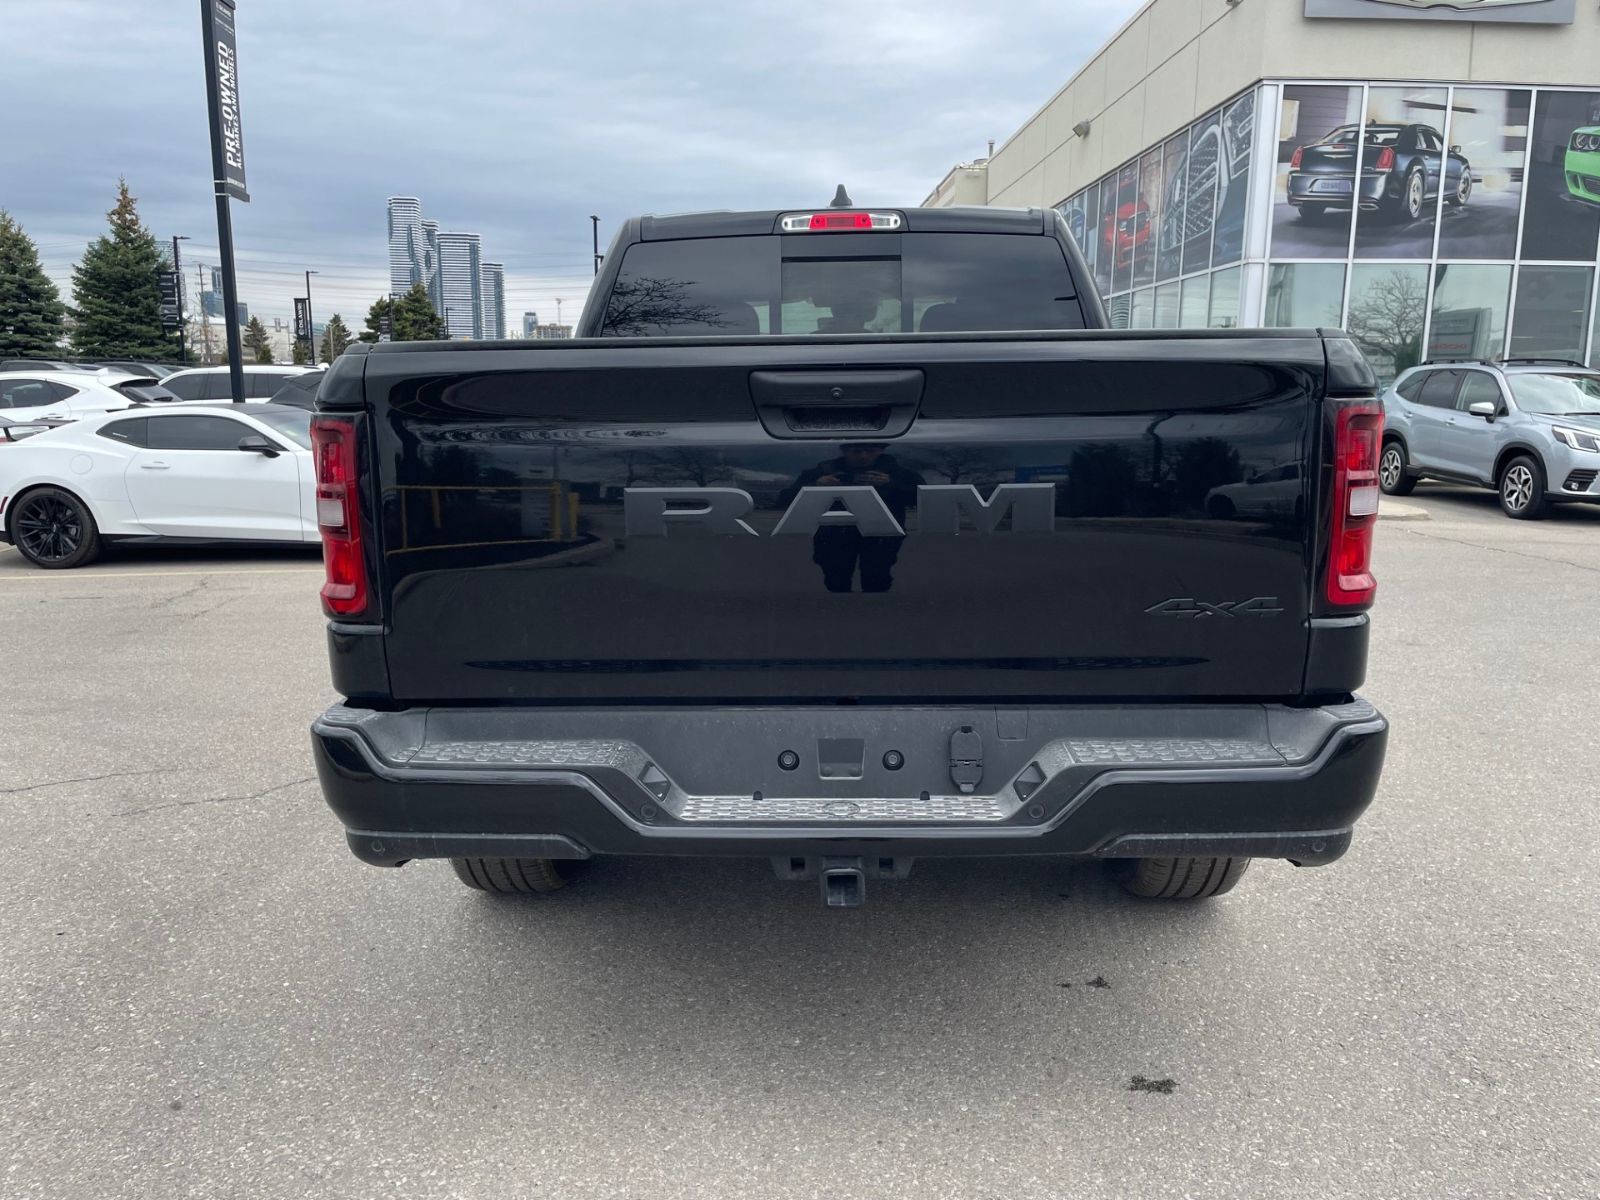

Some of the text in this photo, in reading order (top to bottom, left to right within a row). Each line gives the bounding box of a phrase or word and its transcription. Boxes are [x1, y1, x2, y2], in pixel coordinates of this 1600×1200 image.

[227, 47, 236, 89] MODELS
[217, 40, 237, 168] PRE-OWNED
[232, 113, 241, 149] MAKES
[624, 483, 1056, 536] RAM
